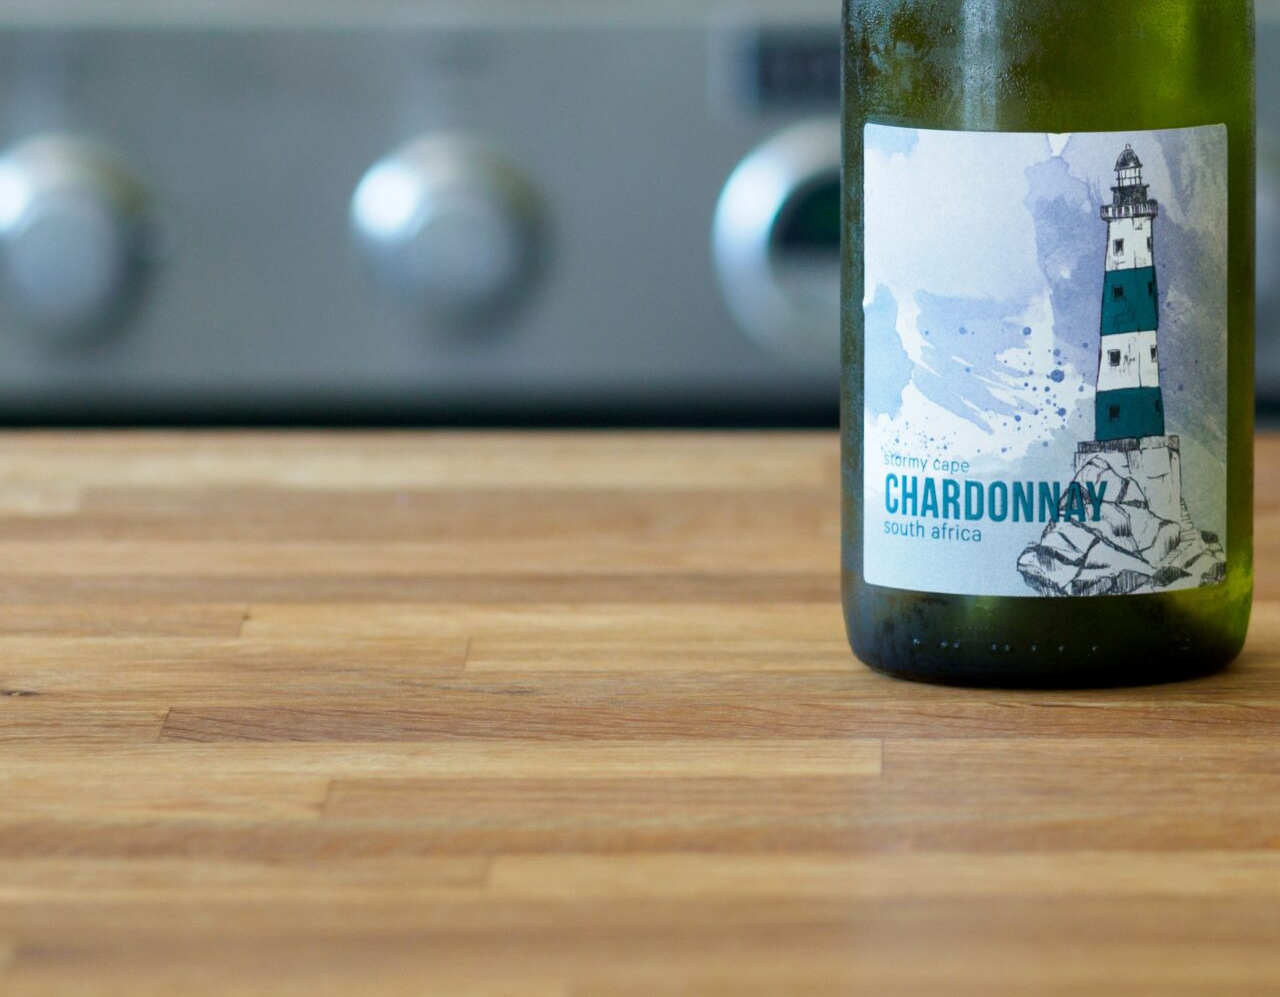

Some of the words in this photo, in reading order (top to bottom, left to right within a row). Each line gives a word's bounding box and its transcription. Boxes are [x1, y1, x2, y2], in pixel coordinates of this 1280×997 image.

[884, 453, 928, 472] stormy
[933, 458, 970, 474] cape
[885, 473, 1108, 523] CHARDONNAY
[884, 520, 926, 538] south
[931, 525, 982, 542] africa
